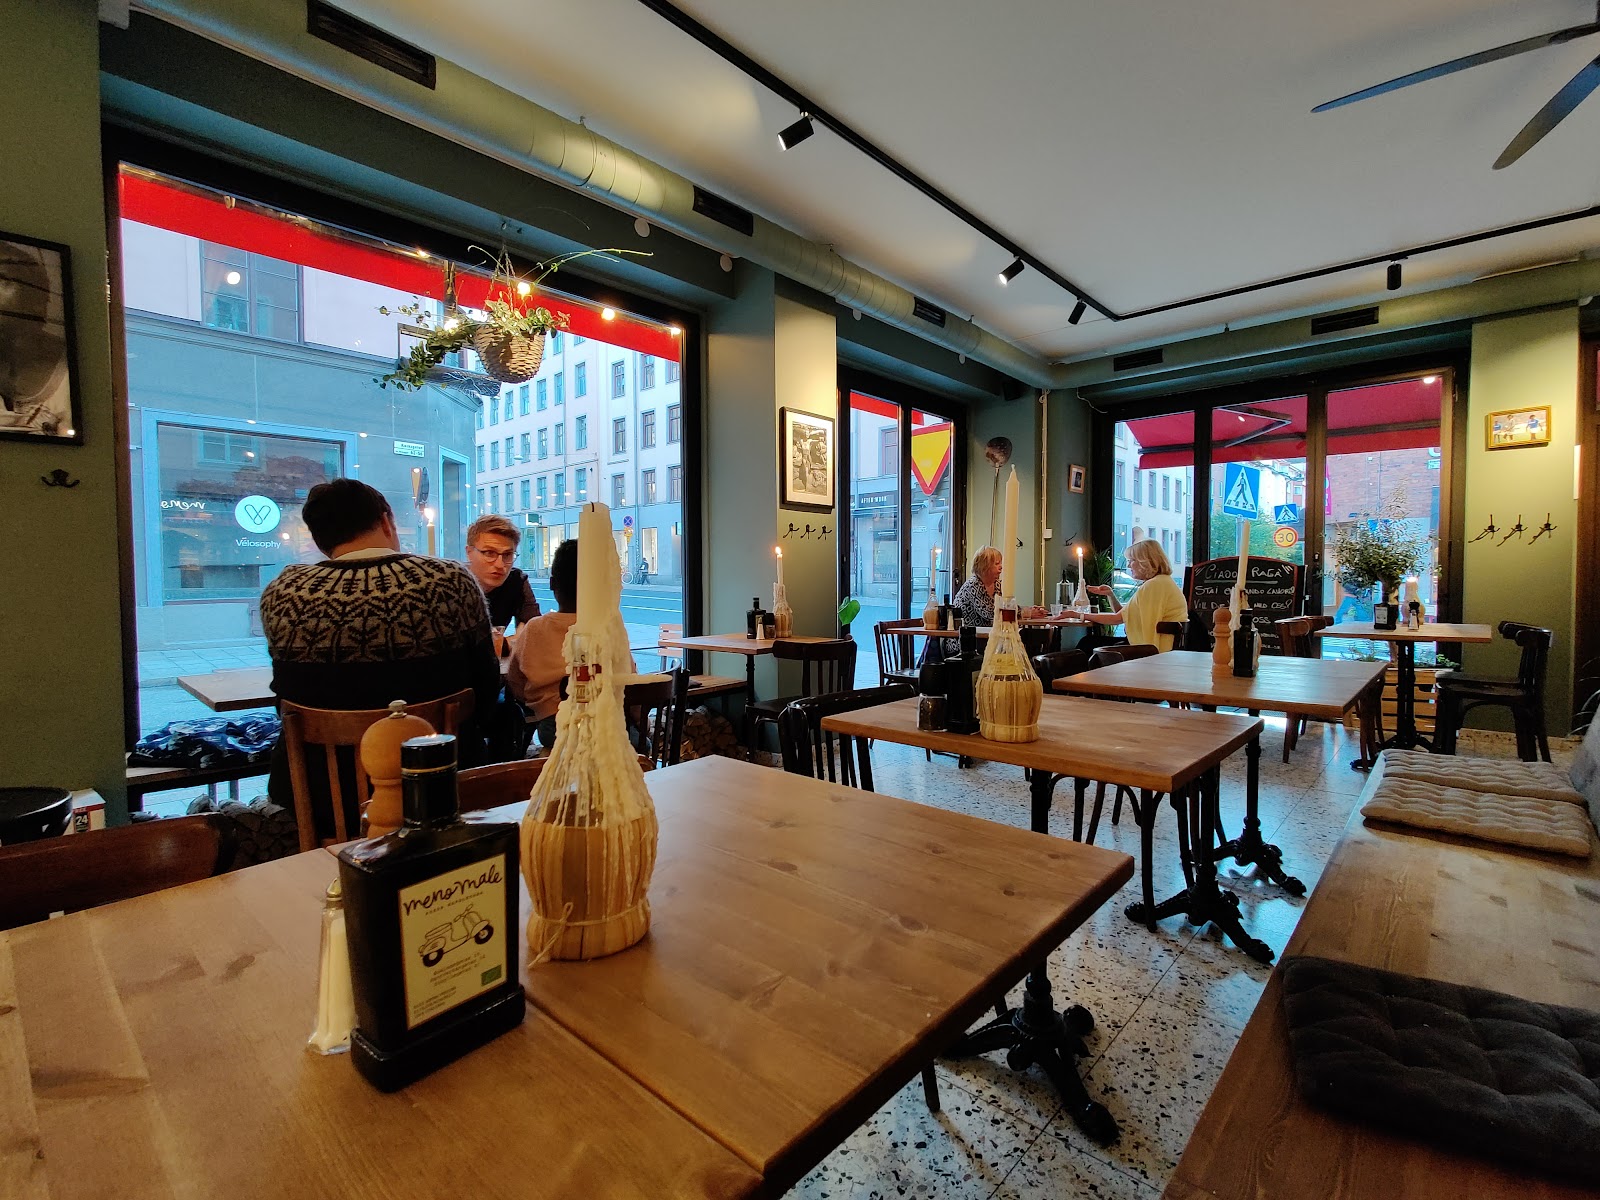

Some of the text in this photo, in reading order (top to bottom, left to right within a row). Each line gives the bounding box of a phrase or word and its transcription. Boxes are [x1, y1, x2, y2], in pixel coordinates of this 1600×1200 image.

[1277, 532, 1294, 543] 30
[236, 538, 281, 549] Vélosophy
[75, 814, 89, 826] 24
